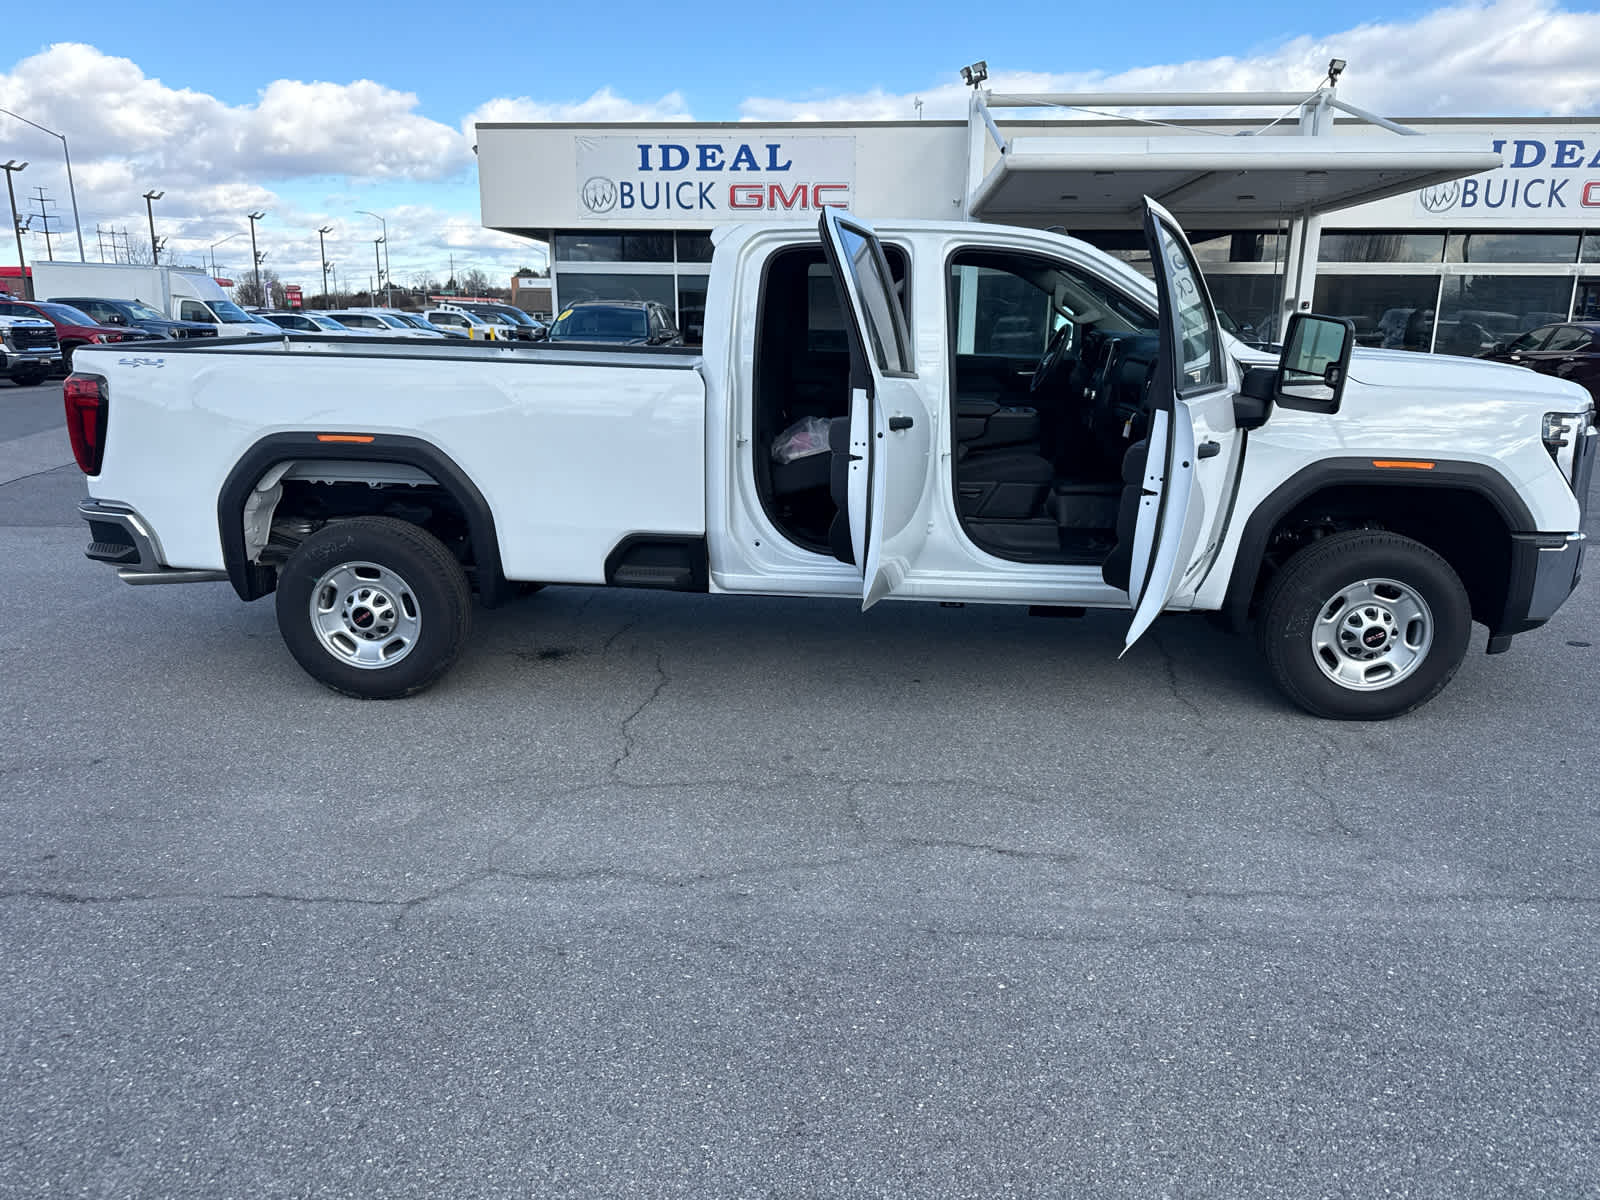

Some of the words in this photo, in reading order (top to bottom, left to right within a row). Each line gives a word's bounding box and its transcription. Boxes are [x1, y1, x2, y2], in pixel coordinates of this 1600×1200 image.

[637, 144, 792, 171] IDEAL
[620, 181, 716, 209] BUICK
[728, 183, 849, 210] GMC
[1461, 178, 1569, 208] BUICK
